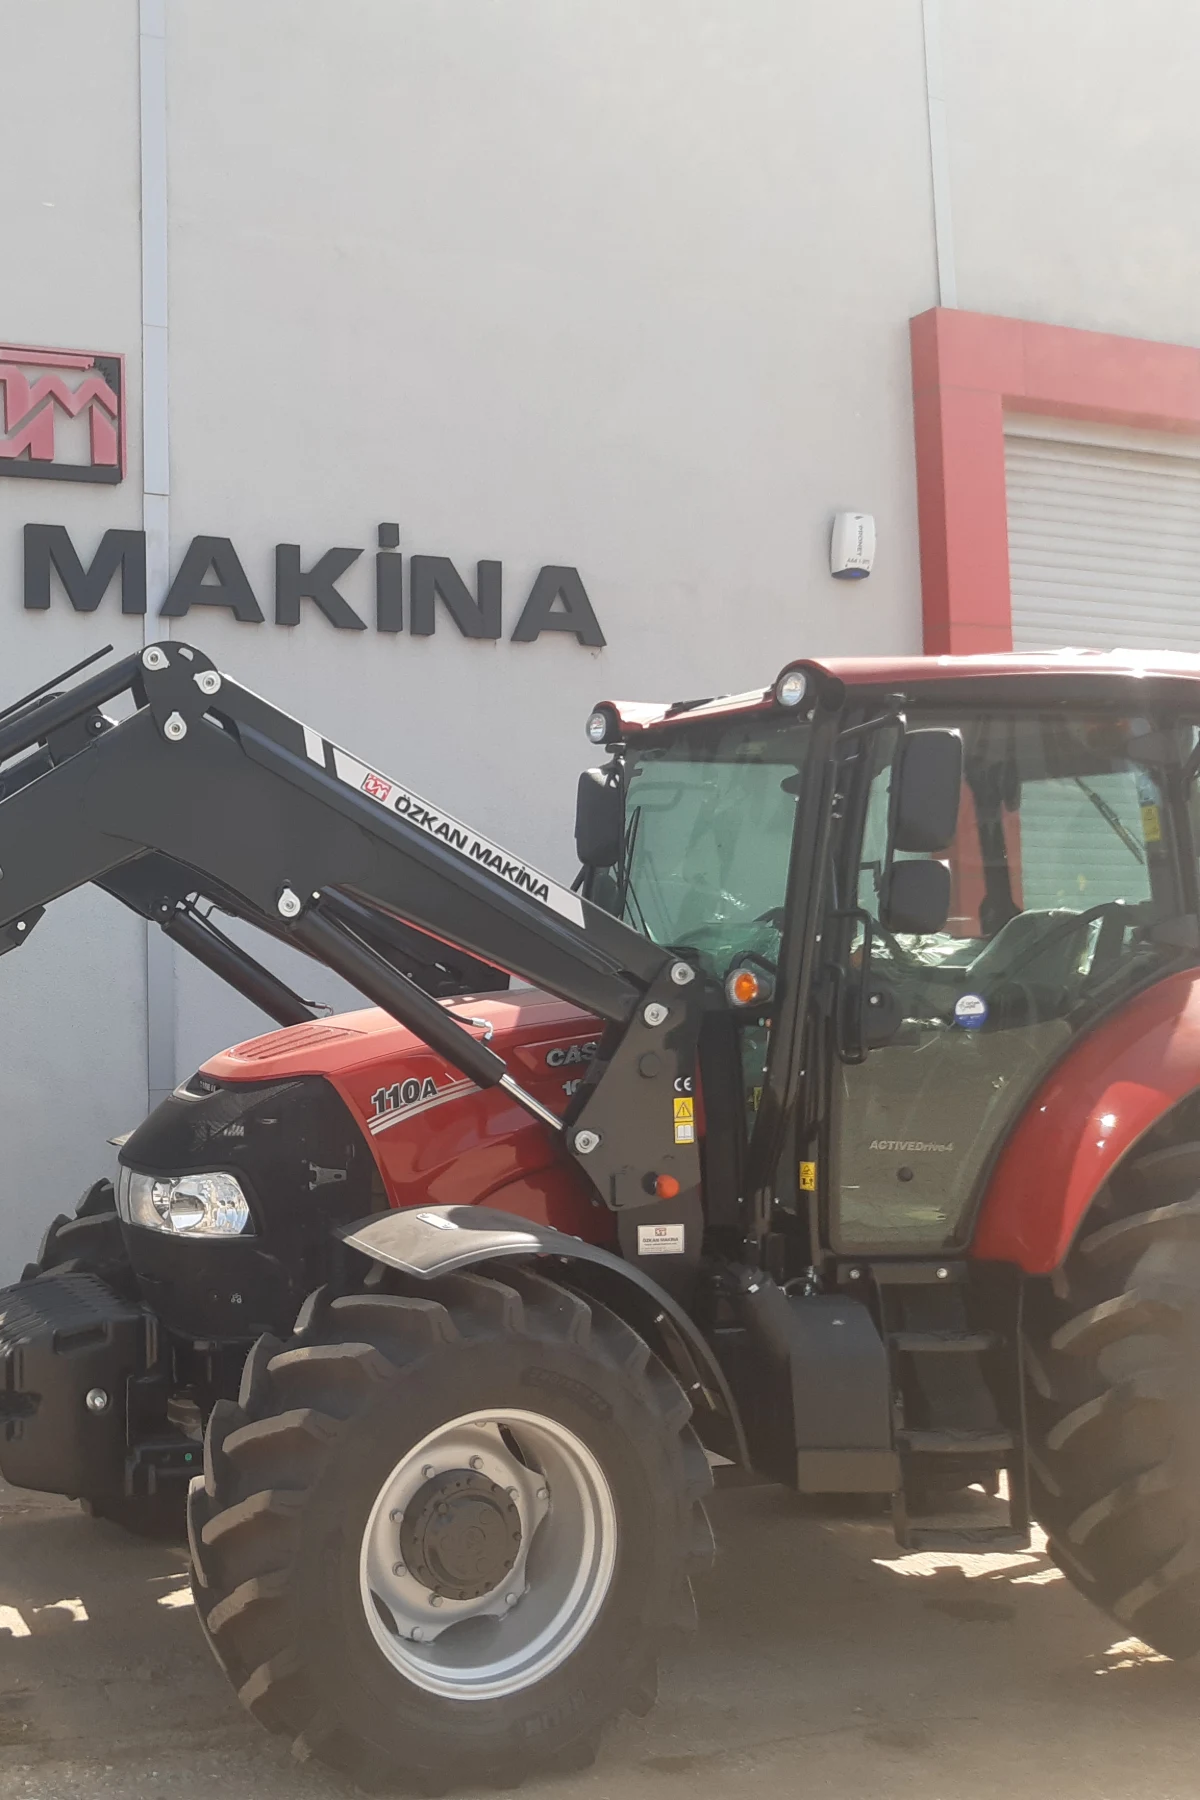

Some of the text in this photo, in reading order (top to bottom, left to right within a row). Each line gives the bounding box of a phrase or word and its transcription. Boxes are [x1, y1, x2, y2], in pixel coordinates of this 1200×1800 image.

[23, 522, 607, 647] MAKİNA
[394, 794, 549, 902] ÖZKAN MAKİNA
[371, 1076, 439, 1115] 110A
